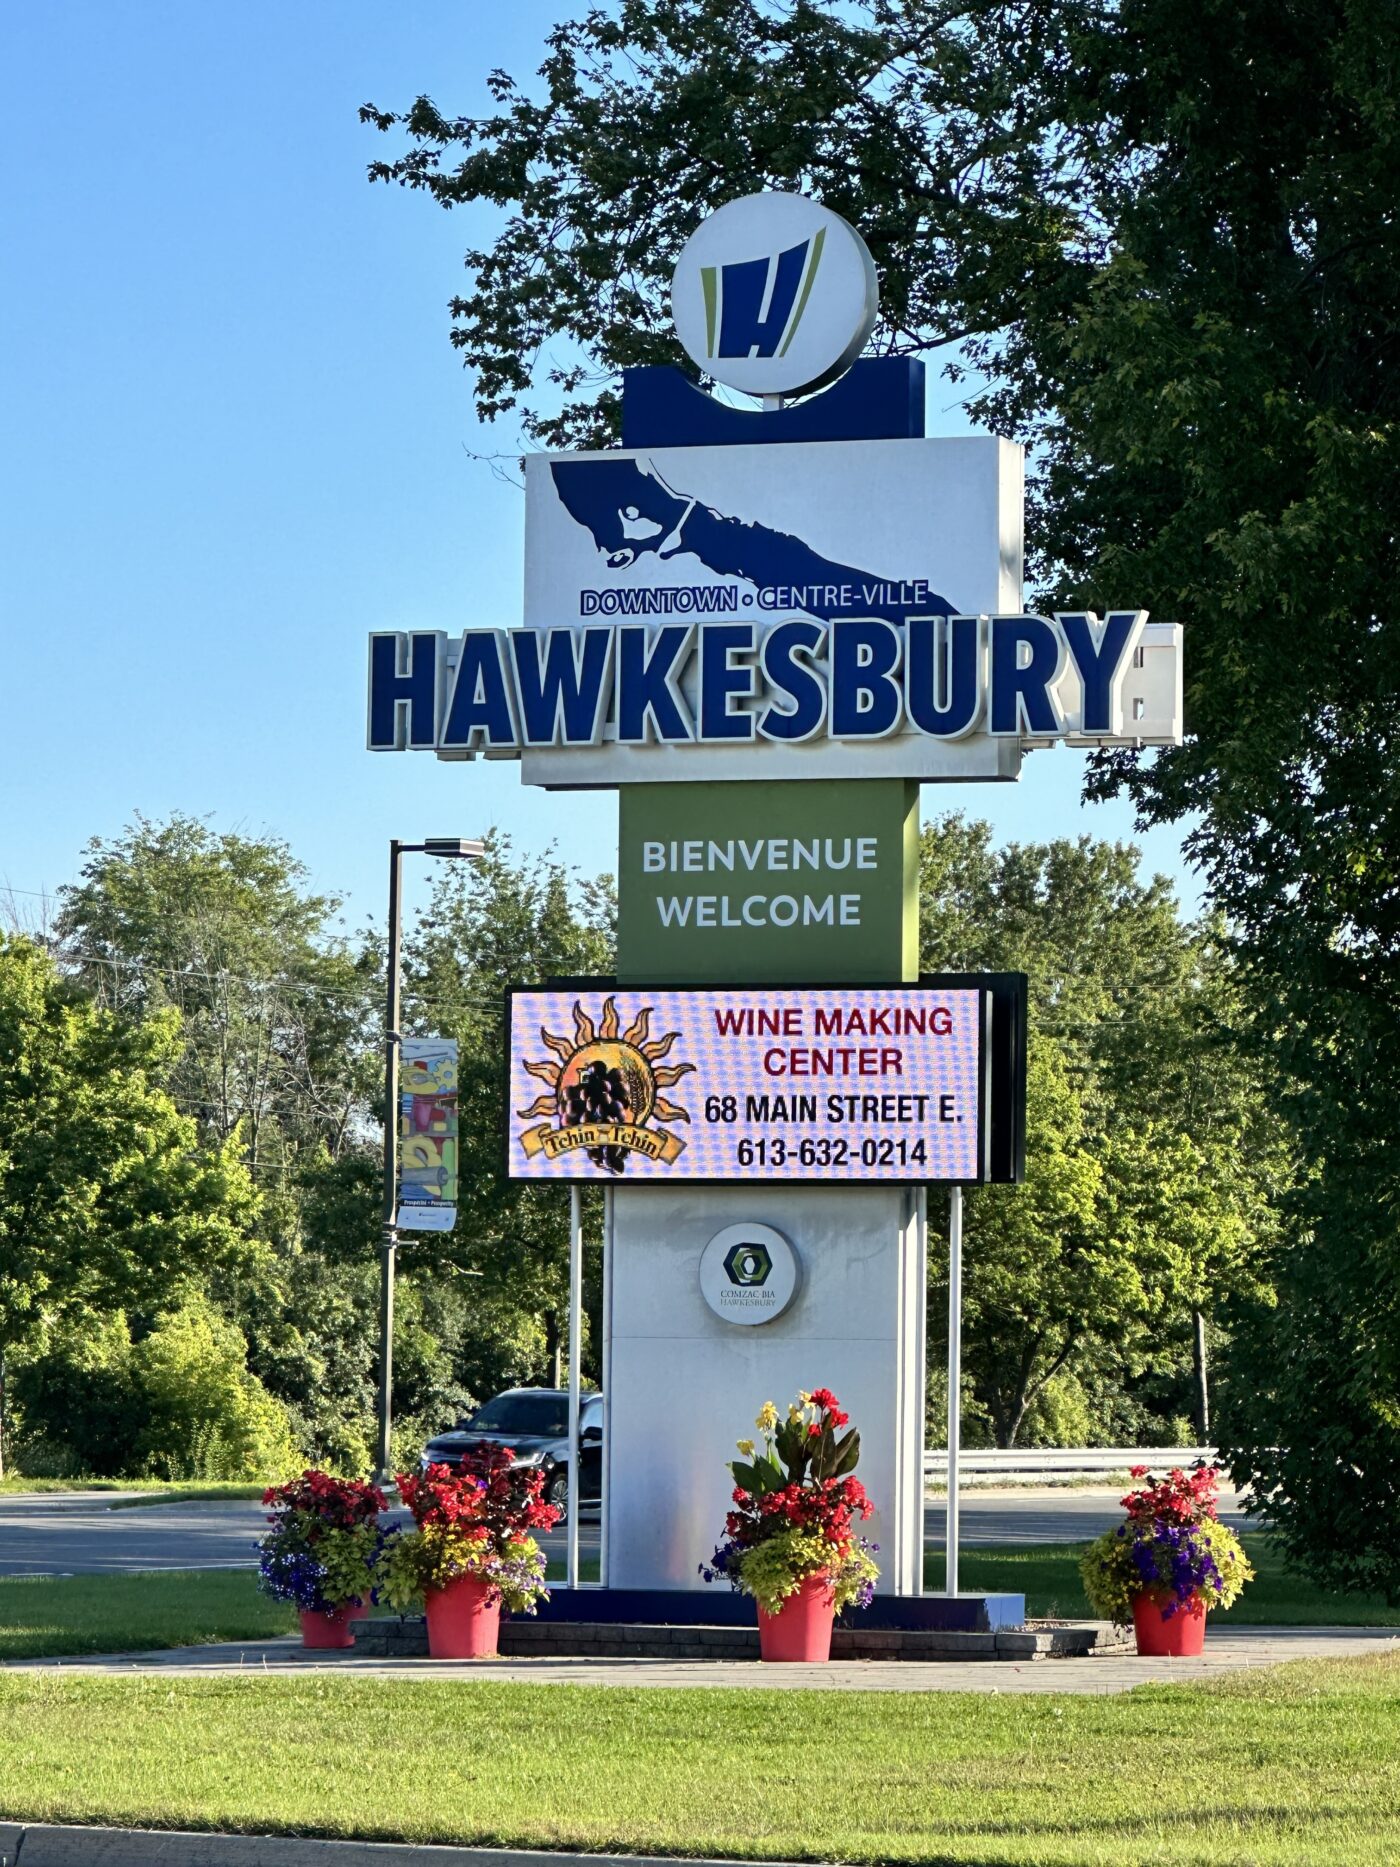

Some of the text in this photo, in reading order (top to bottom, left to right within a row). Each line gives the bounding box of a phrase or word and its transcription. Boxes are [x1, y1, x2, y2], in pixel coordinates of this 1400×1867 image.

[581, 579, 929, 616] DOWNTOWN CENTRE-VILLE
[366, 609, 1150, 751] HAWKESBURY
[643, 837, 878, 872] BIENVENUE
[656, 894, 861, 927] WELCOME
[715, 1007, 953, 1036] WINE MAKING
[763, 1048, 903, 1076] CENTER
[704, 1094, 963, 1123] 68 MAIN STREET E.
[737, 1138, 928, 1167] 613-632-0214
